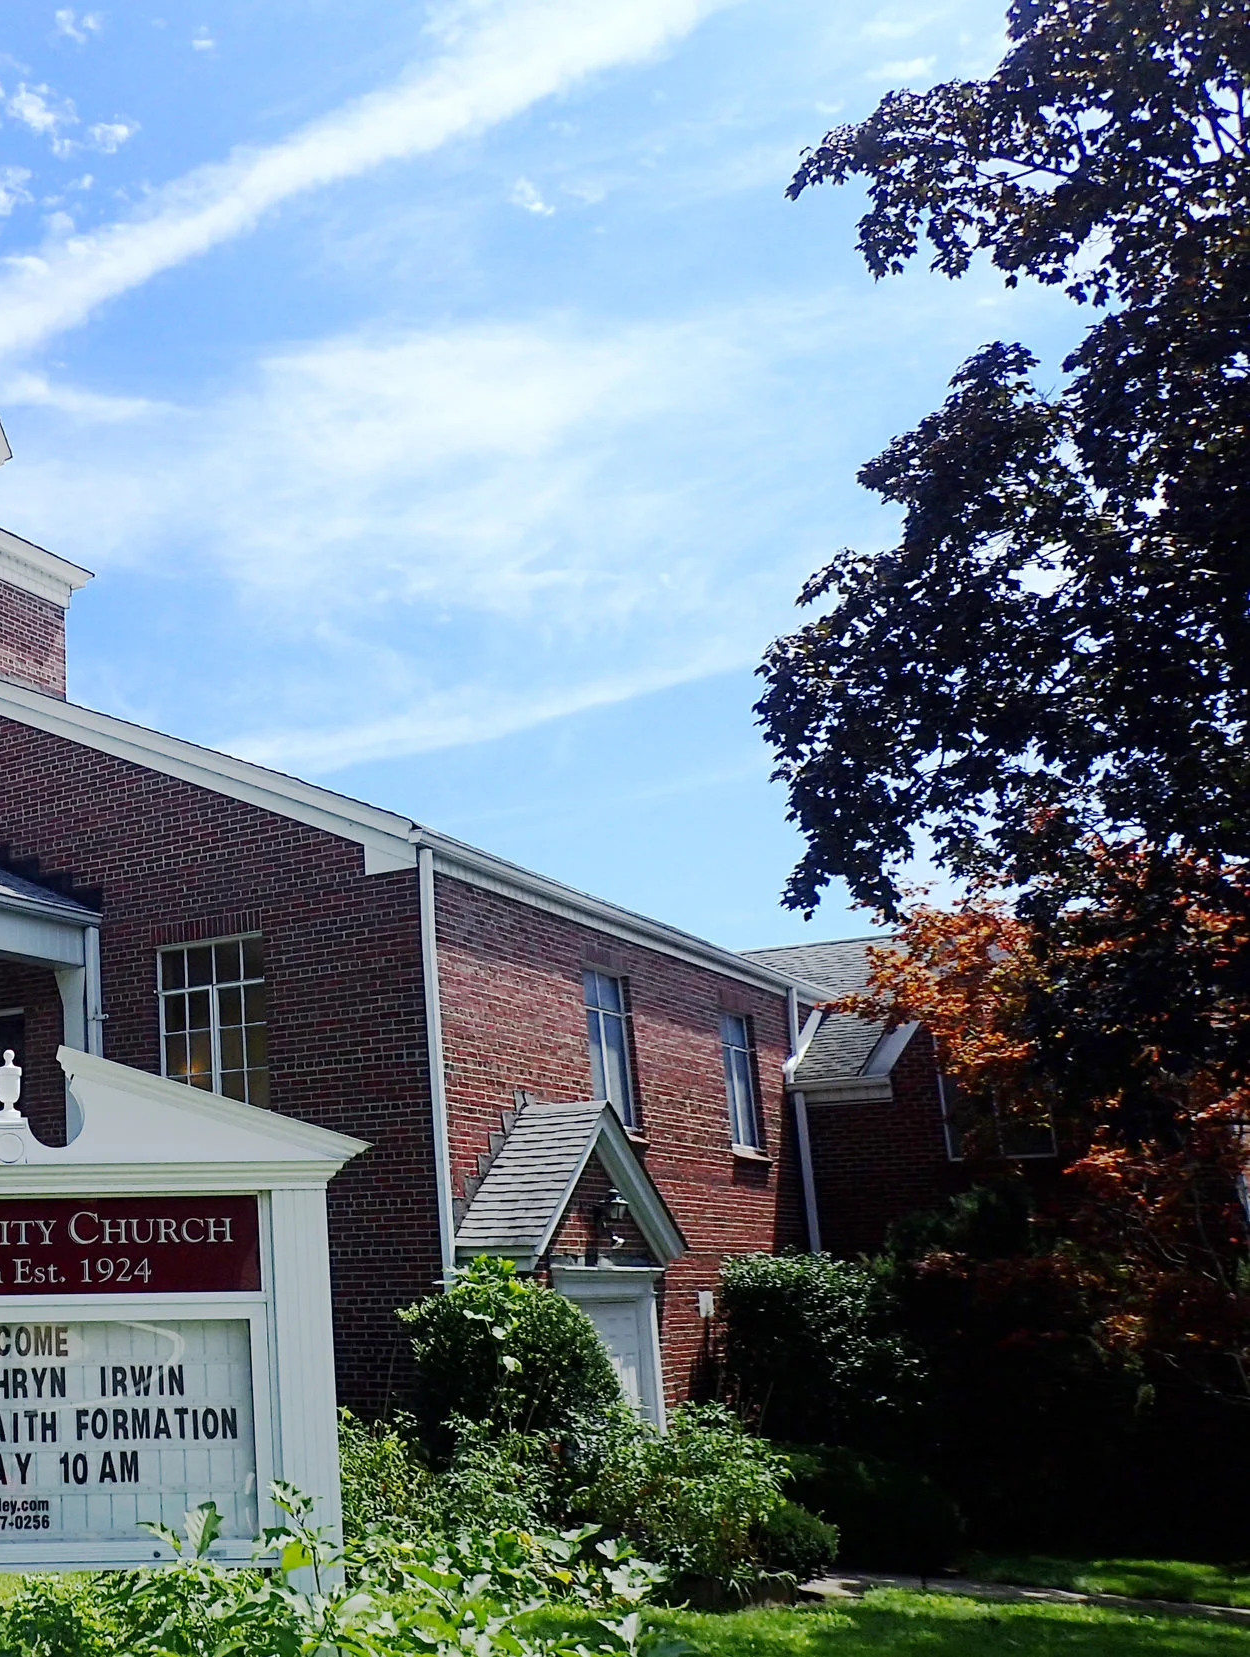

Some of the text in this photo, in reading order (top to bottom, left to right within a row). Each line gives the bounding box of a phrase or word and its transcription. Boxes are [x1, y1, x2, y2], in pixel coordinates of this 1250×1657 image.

[68, 1211, 233, 1245] CHURCH
[12, 1258, 66, 1284] Est.
[80, 1257, 152, 1283] 1924
[100, 1364, 185, 1397] IRWIN
[76, 1407, 238, 1440] FORMATION
[60, 1451, 88, 1484] 10
[99, 1451, 139, 1483] AM
